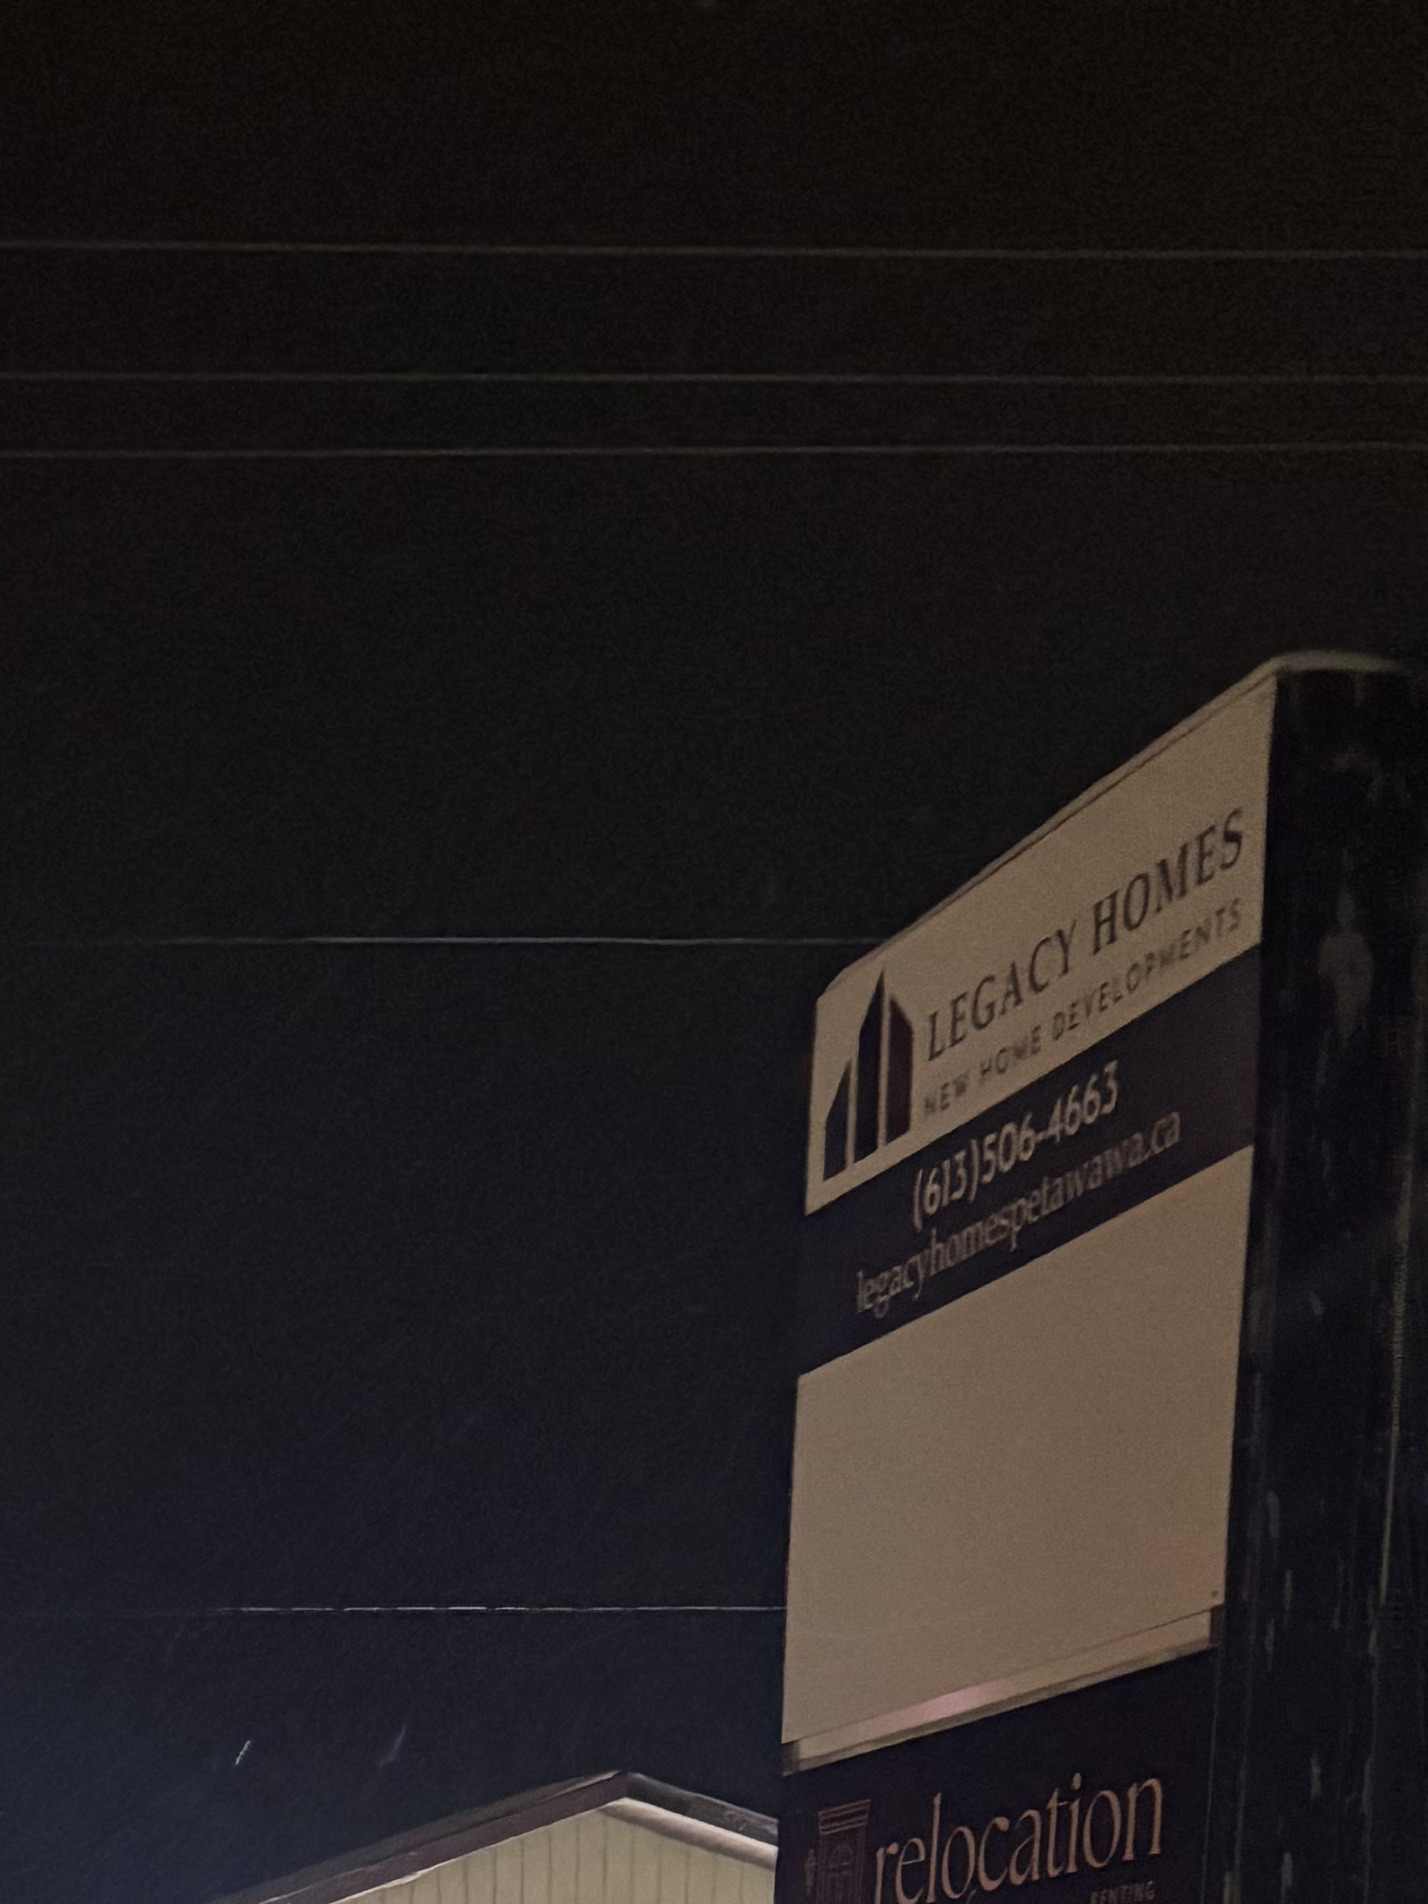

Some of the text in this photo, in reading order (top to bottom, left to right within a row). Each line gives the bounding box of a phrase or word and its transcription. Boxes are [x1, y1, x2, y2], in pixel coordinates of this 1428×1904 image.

[923, 896, 1243, 1118] NEW HOME DEVELOPMENTS
[926, 806, 1246, 1062] LEGACY HOMES
[856, 1108, 1182, 1319] legacyhomespetawawa.ca
[912, 1058, 1121, 1233] (613)506-4663
